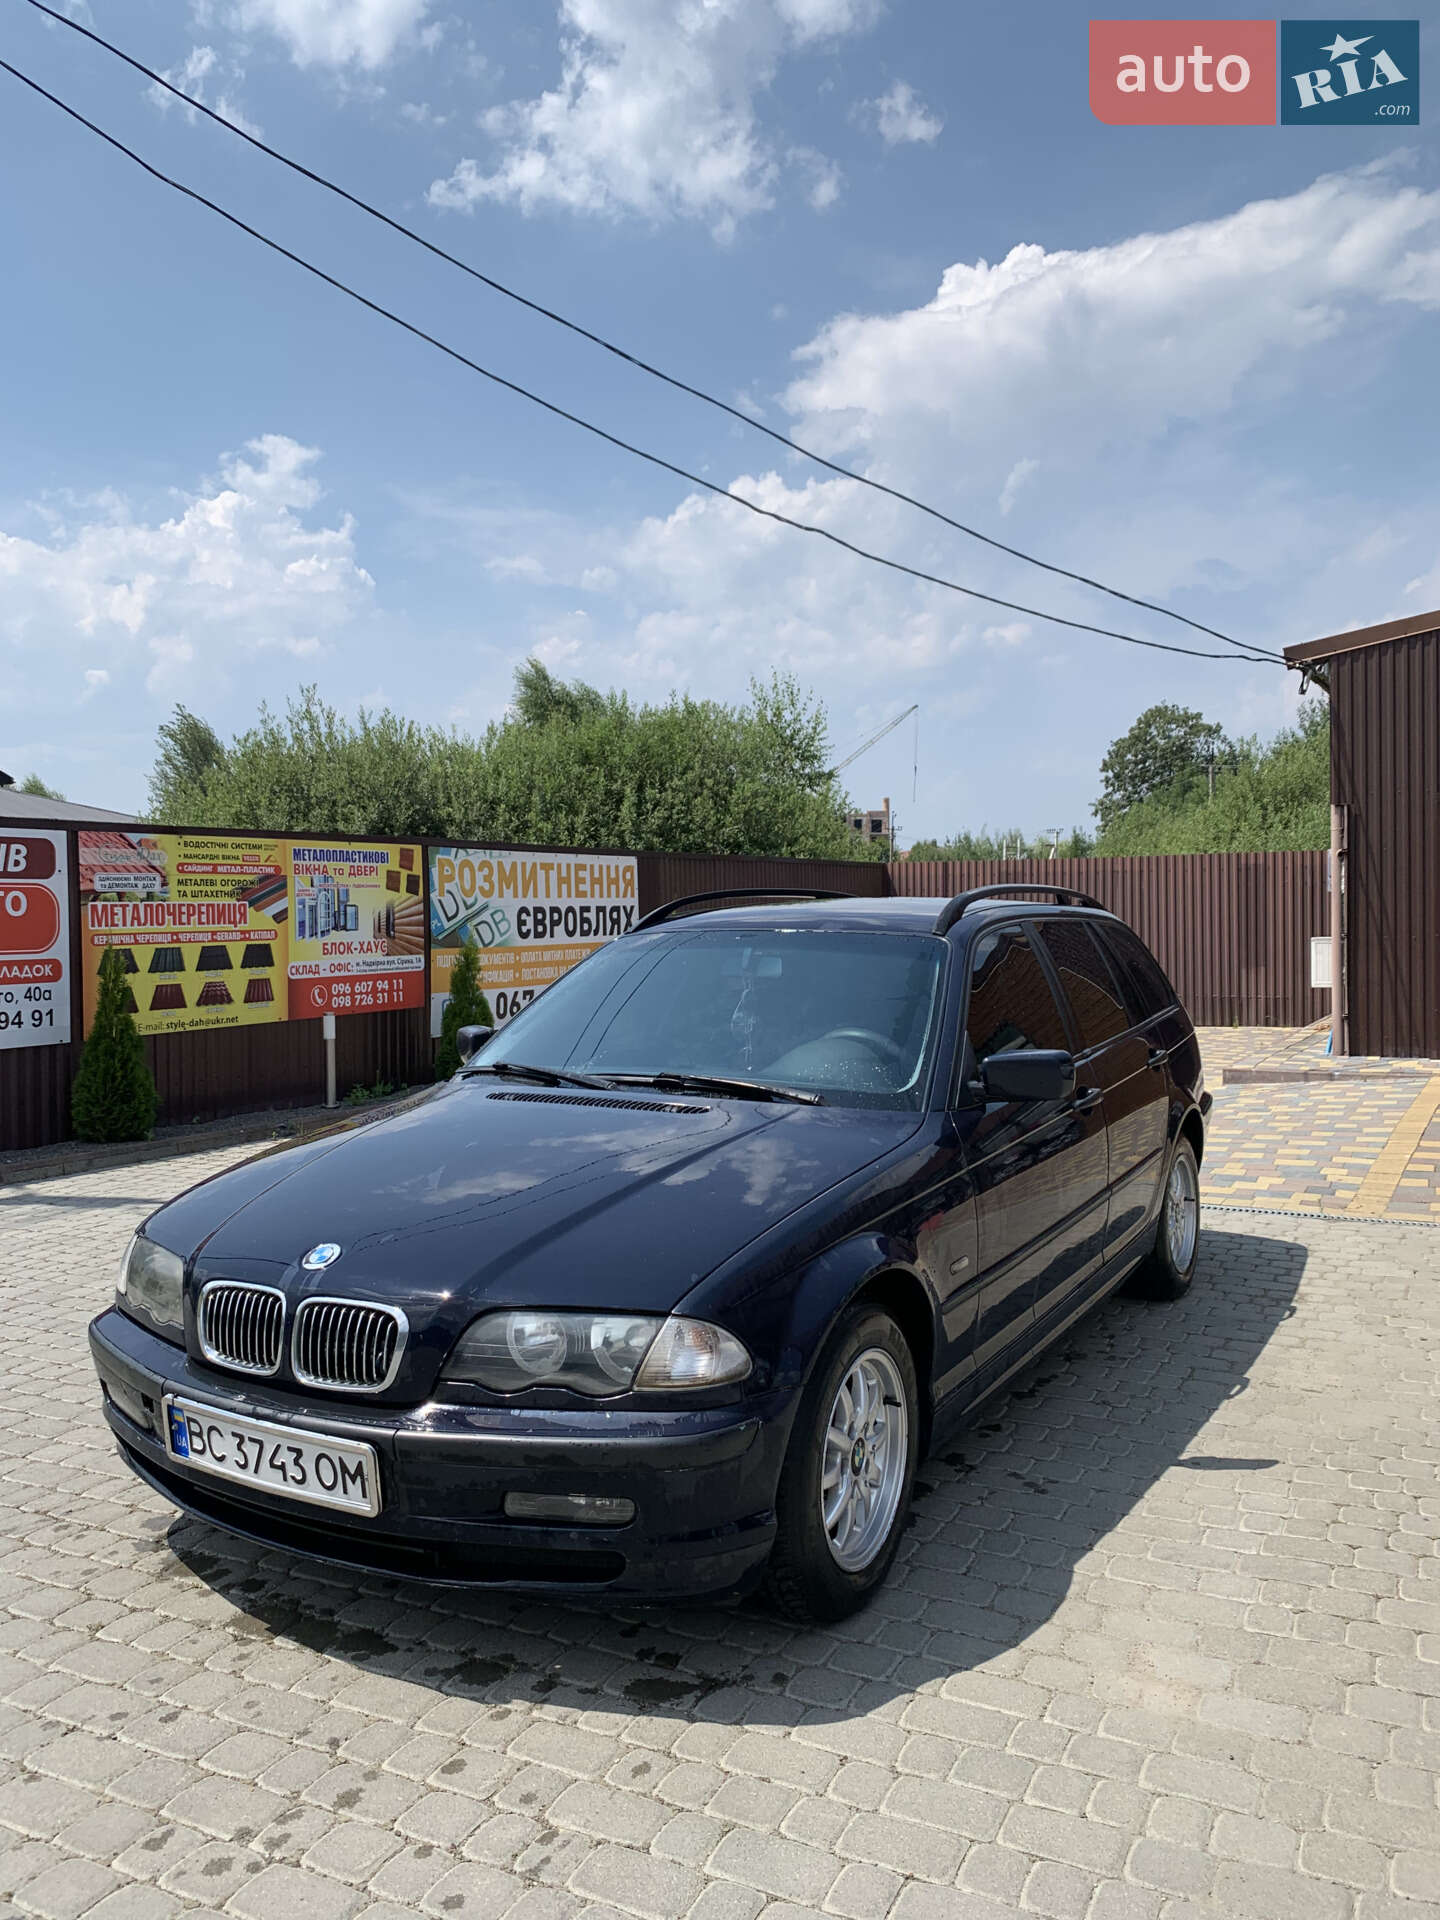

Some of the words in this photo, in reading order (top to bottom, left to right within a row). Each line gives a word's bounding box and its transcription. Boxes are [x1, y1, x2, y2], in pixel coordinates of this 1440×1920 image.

[183, 840, 229, 849] ВОДОСТІЧНІ
[230, 842, 263, 850] СИСТЕМИ
[183, 853, 220, 861] МАНСАРДНІ
[292, 848, 389, 864] МЕТАЛОПЛАСТИКОВІ
[183, 864, 213, 873] САЙДИНГ
[217, 865, 275, 874] МЕТАЛ-ПЛАСТИК
[293, 864, 329, 876] ВІКНА
[333, 868, 344, 876] та
[348, 865, 379, 878] ДВЕРІ
[177, 879, 217, 887] МЕТАЛЕВІ
[220, 879, 260, 888] ОГОРОЖІ
[437, 857, 635, 898] РОЗМИТНЕННЯ
[177, 890, 188, 898] ТА
[191, 890, 241, 899] ШТАХЕТНИК
[90, 903, 249, 928] МЕТАЛОЧЕРЕПИЦЯ
[517, 905, 635, 940] ЄВРОБЛЯХ
[322, 939, 387, 956] БЛОК-ХАУС
[289, 964, 320, 977] СКЛАД
[331, 983, 351, 995] 096
[354, 981, 374, 993] 607
[376, 980, 389, 992] 94
[393, 979, 404, 990] 11
[331, 996, 351, 1008] 098
[354, 994, 374, 1007] 726
[376, 992, 389, 1004] 31
[393, 991, 404, 1003] 11
[0, 1010, 24, 1030] 94
[31, 1008, 54, 1028] 91
[137, 1022, 164, 1032] E-mail:
[166, 1015, 239, 1030] style-dah@ukr.net
[176, 1434, 188, 1448] UA
[230, 1431, 307, 1485] 3743
